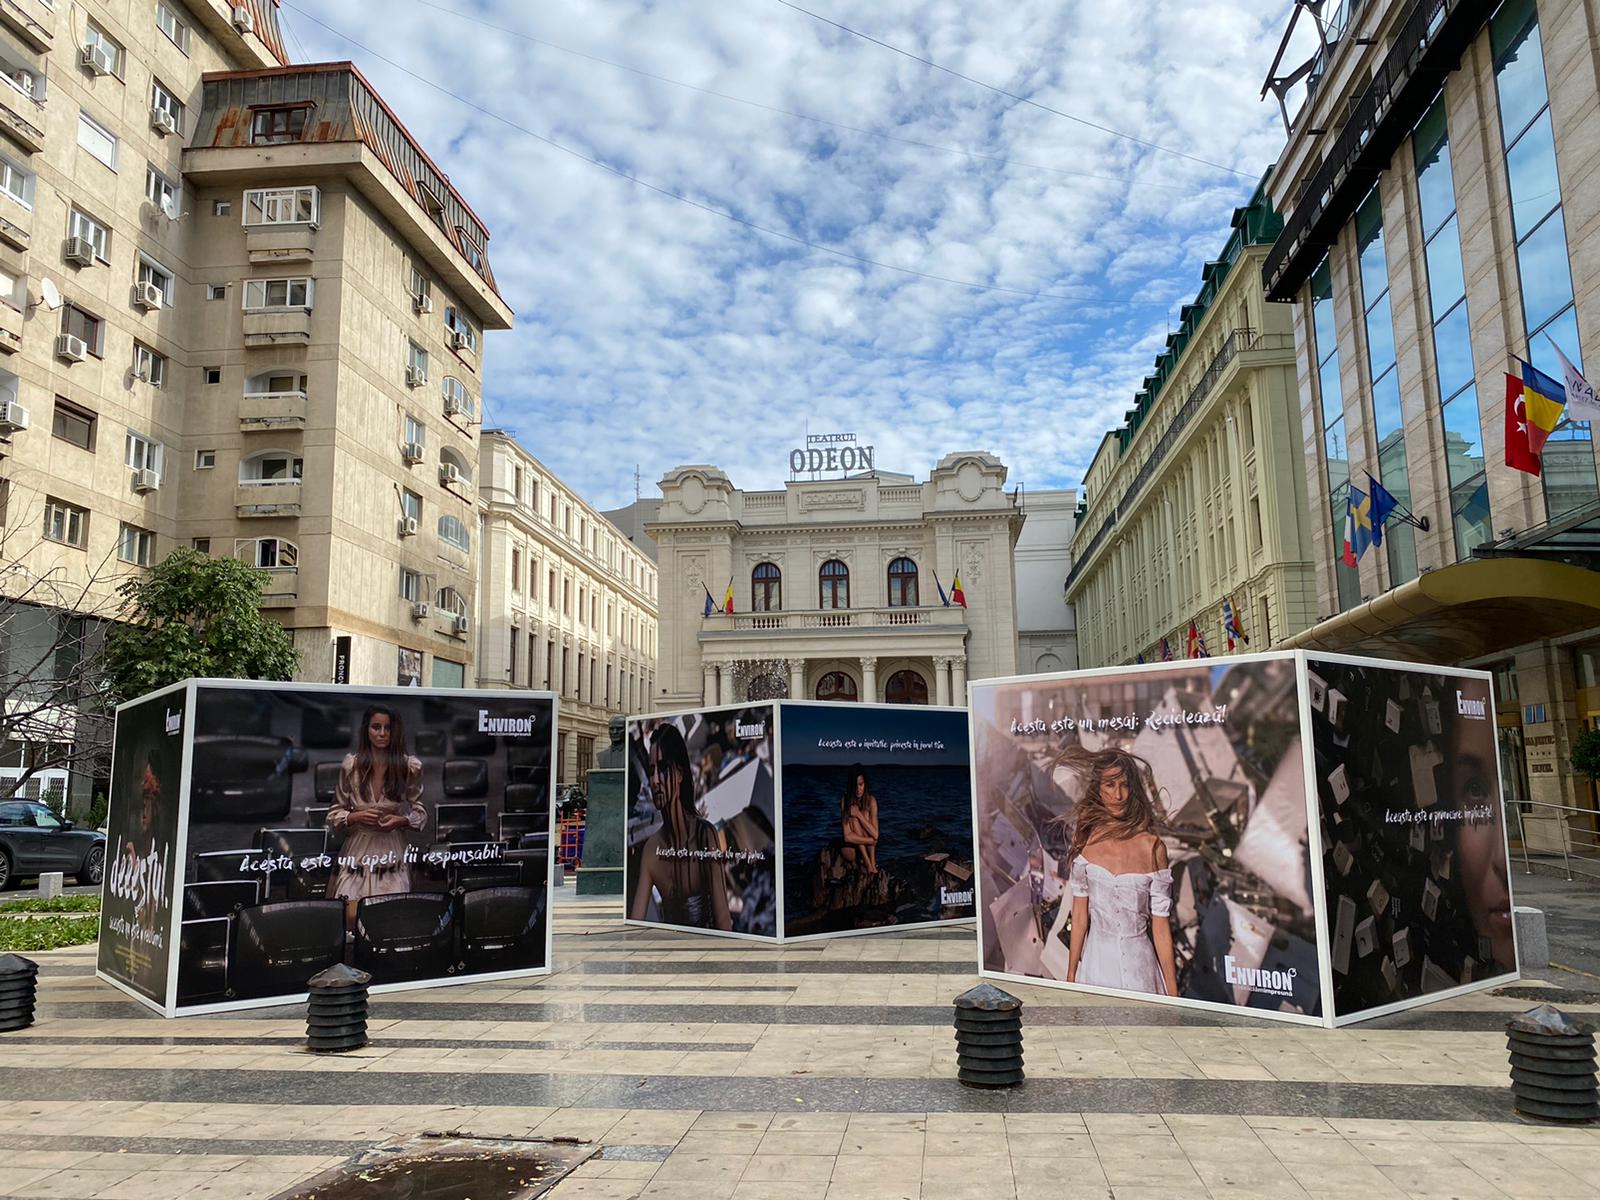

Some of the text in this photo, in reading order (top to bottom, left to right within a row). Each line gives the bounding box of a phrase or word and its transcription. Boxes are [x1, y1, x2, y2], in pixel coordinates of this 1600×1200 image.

[808, 434, 856, 443] TEATRUL
[790, 446, 873, 473] ODEON
[1011, 705, 1227, 734] Acesta este un mesaj: Reciclează!
[240, 843, 502, 872] Acesta este un apel: fii responsabil.
[1224, 955, 1294, 991] ENVIRON
